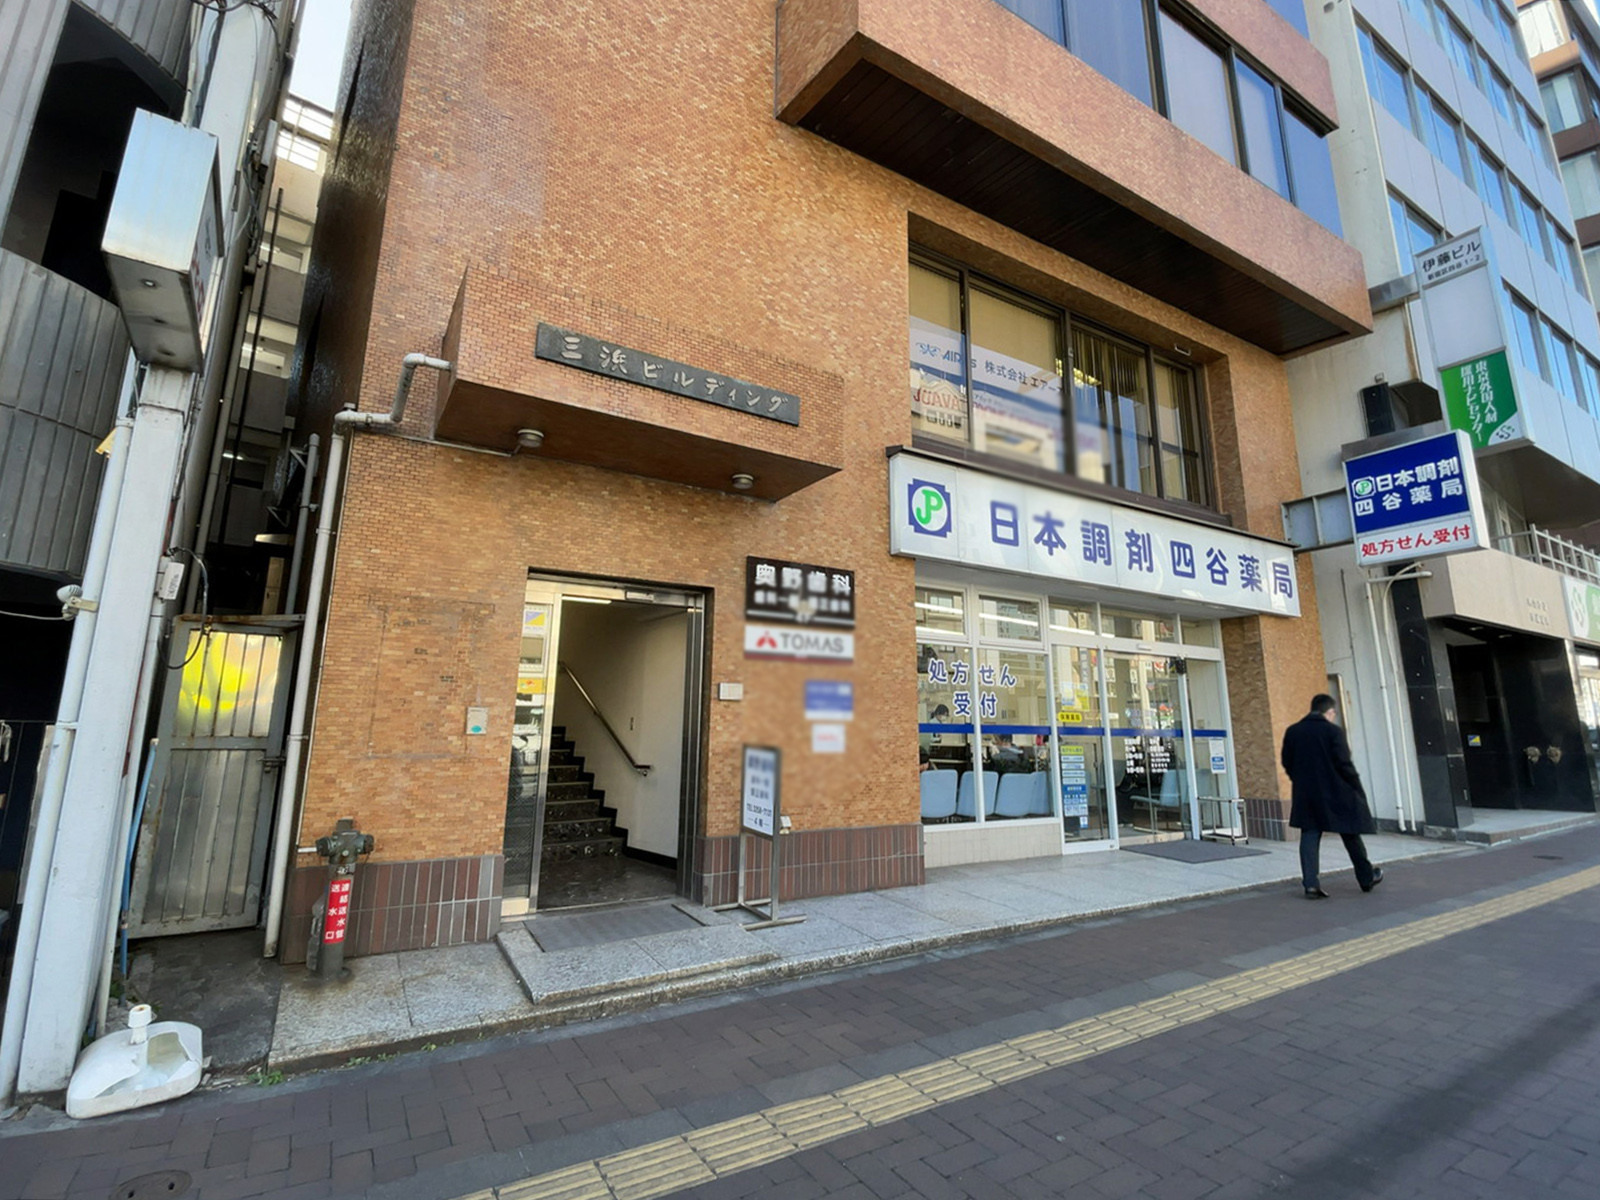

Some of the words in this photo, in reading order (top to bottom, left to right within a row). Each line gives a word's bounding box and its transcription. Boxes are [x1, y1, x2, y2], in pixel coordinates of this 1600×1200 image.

[1422, 241, 1481, 273] 伊藤ビル
[561, 336, 789, 413] 三浜ビルディング
[1376, 456, 1460, 493] 日本調剤
[1354, 478, 1463, 517] 四谷薬局
[990, 500, 1294, 600] 日本調剤四谷薬局
[1361, 524, 1471, 557] 処方せん受付
[780, 632, 844, 653] TOMAS
[929, 658, 1017, 687] 処方せん
[953, 691, 998, 718] 受付
